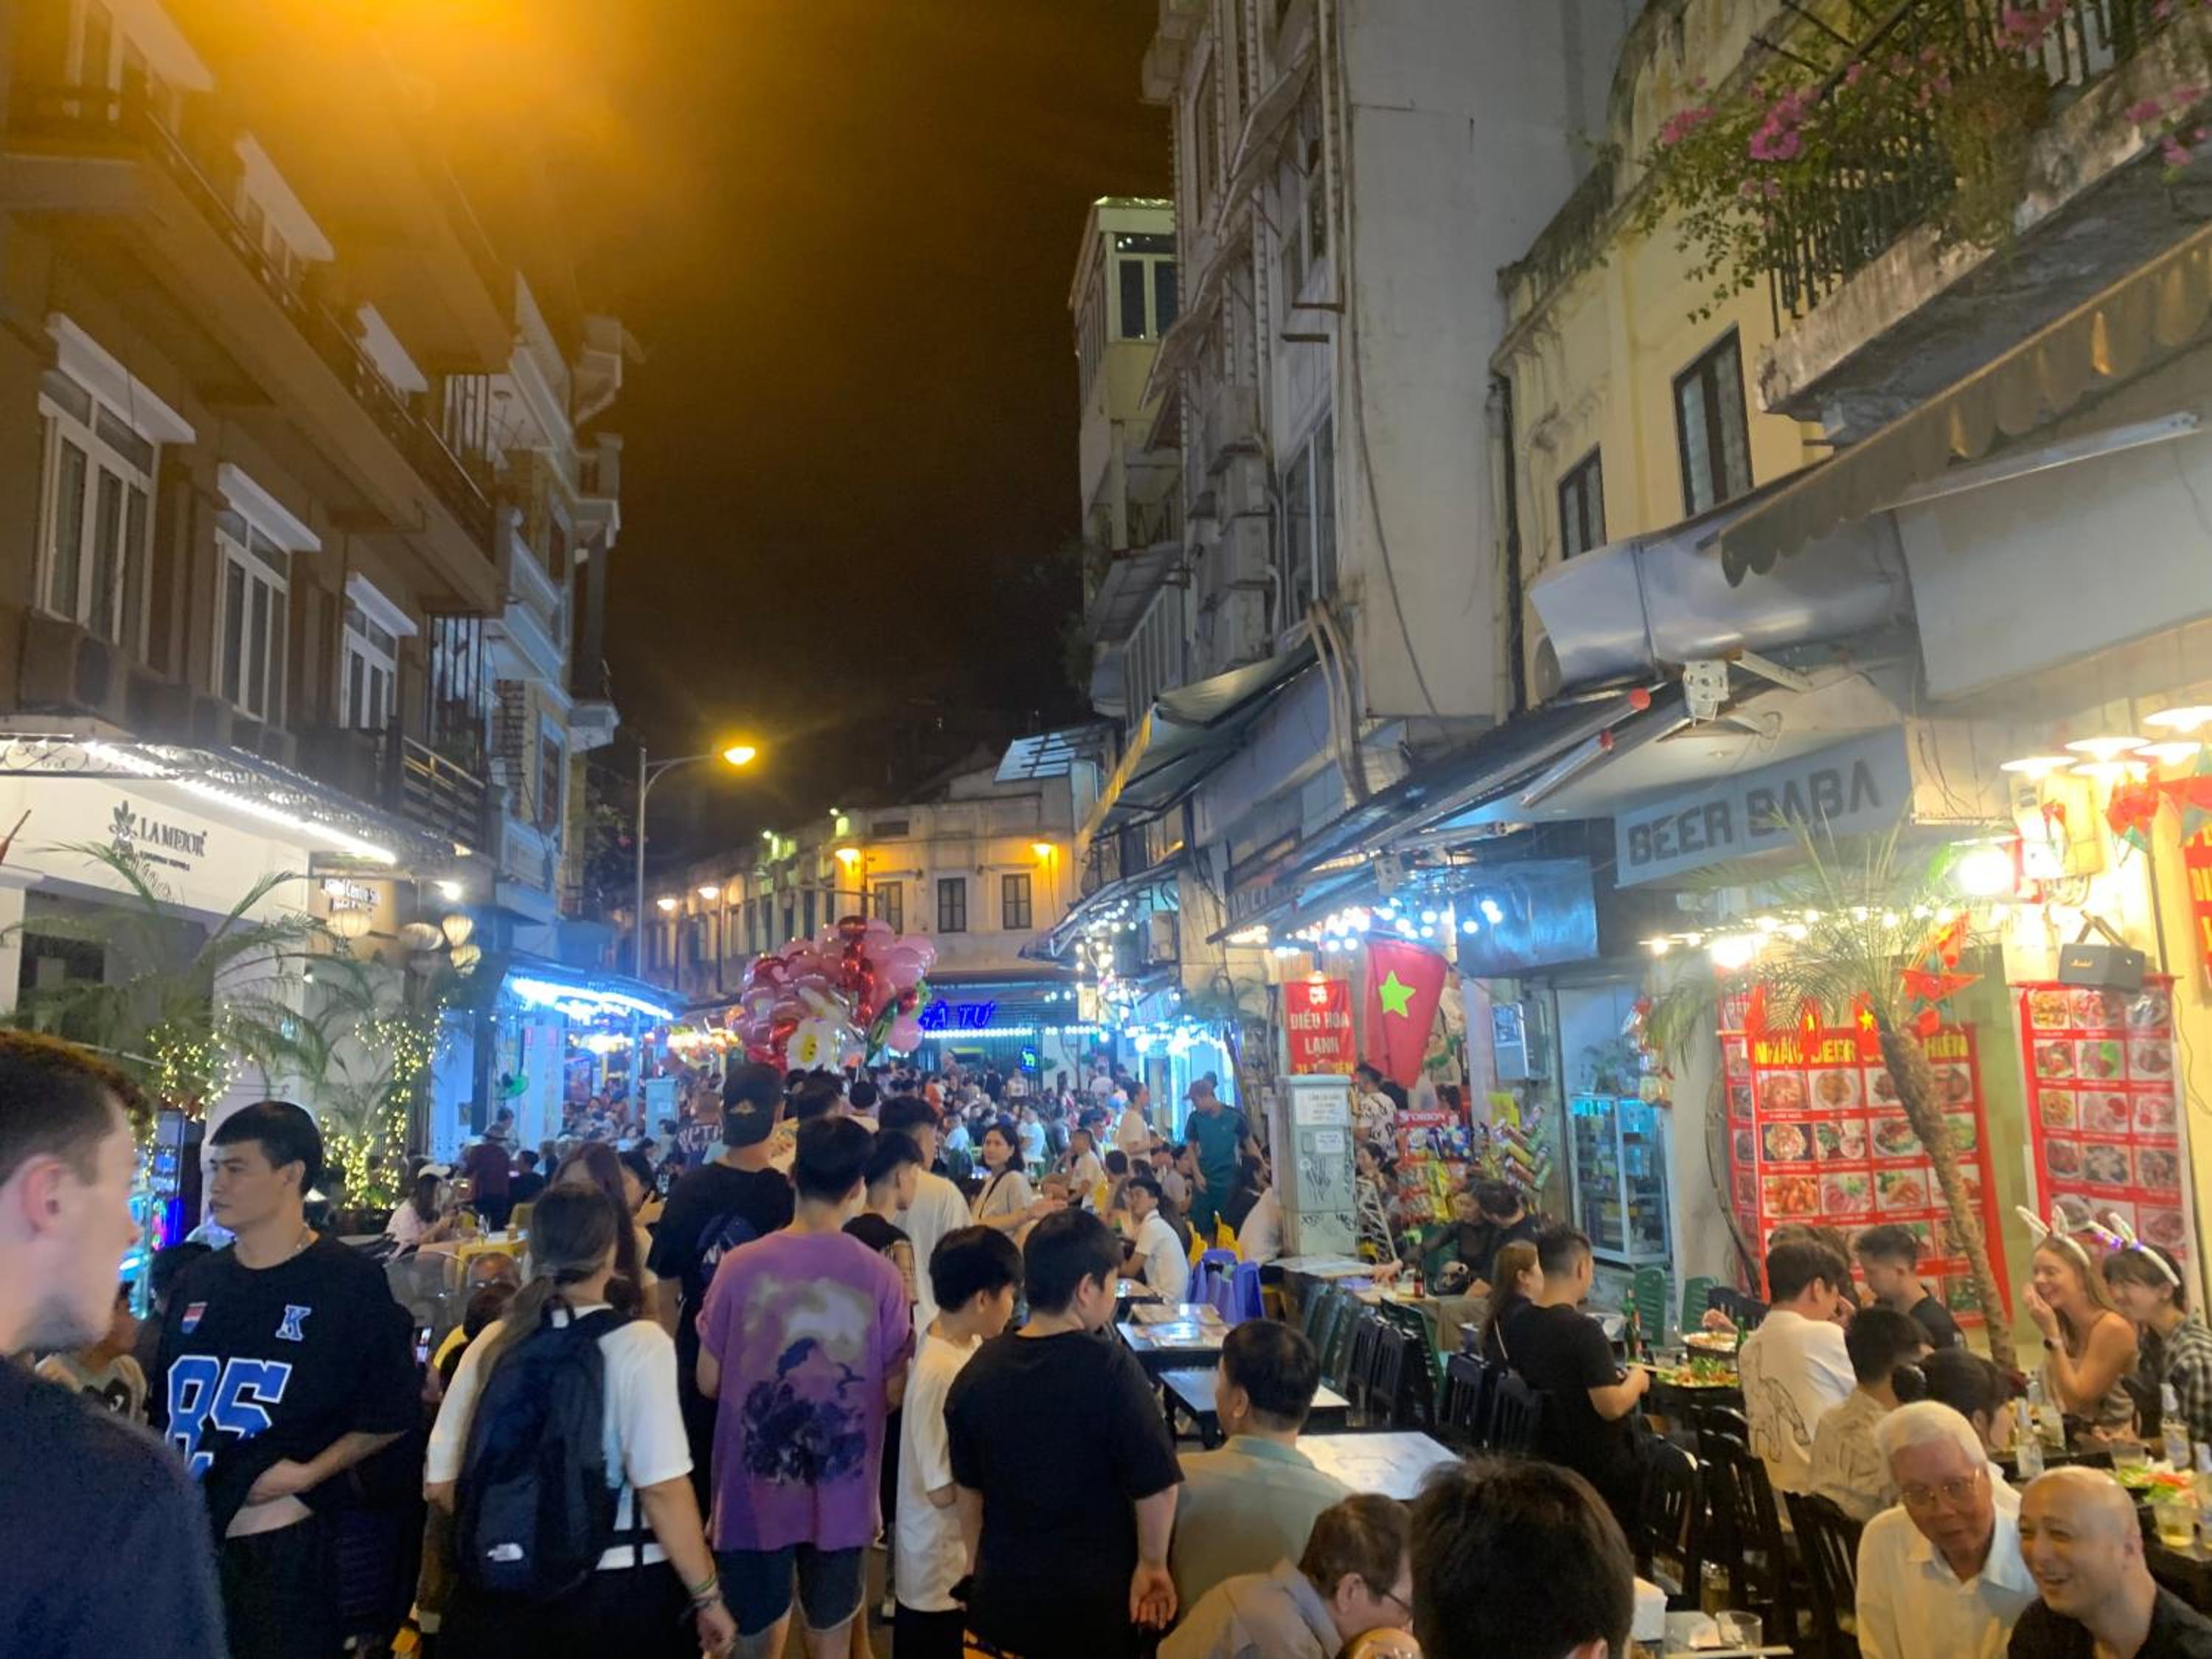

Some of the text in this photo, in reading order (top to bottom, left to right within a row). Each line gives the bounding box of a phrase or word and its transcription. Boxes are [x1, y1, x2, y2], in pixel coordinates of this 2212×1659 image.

[1627, 759, 1882, 867] BEER BABA
[275, 1304, 312, 1341] K
